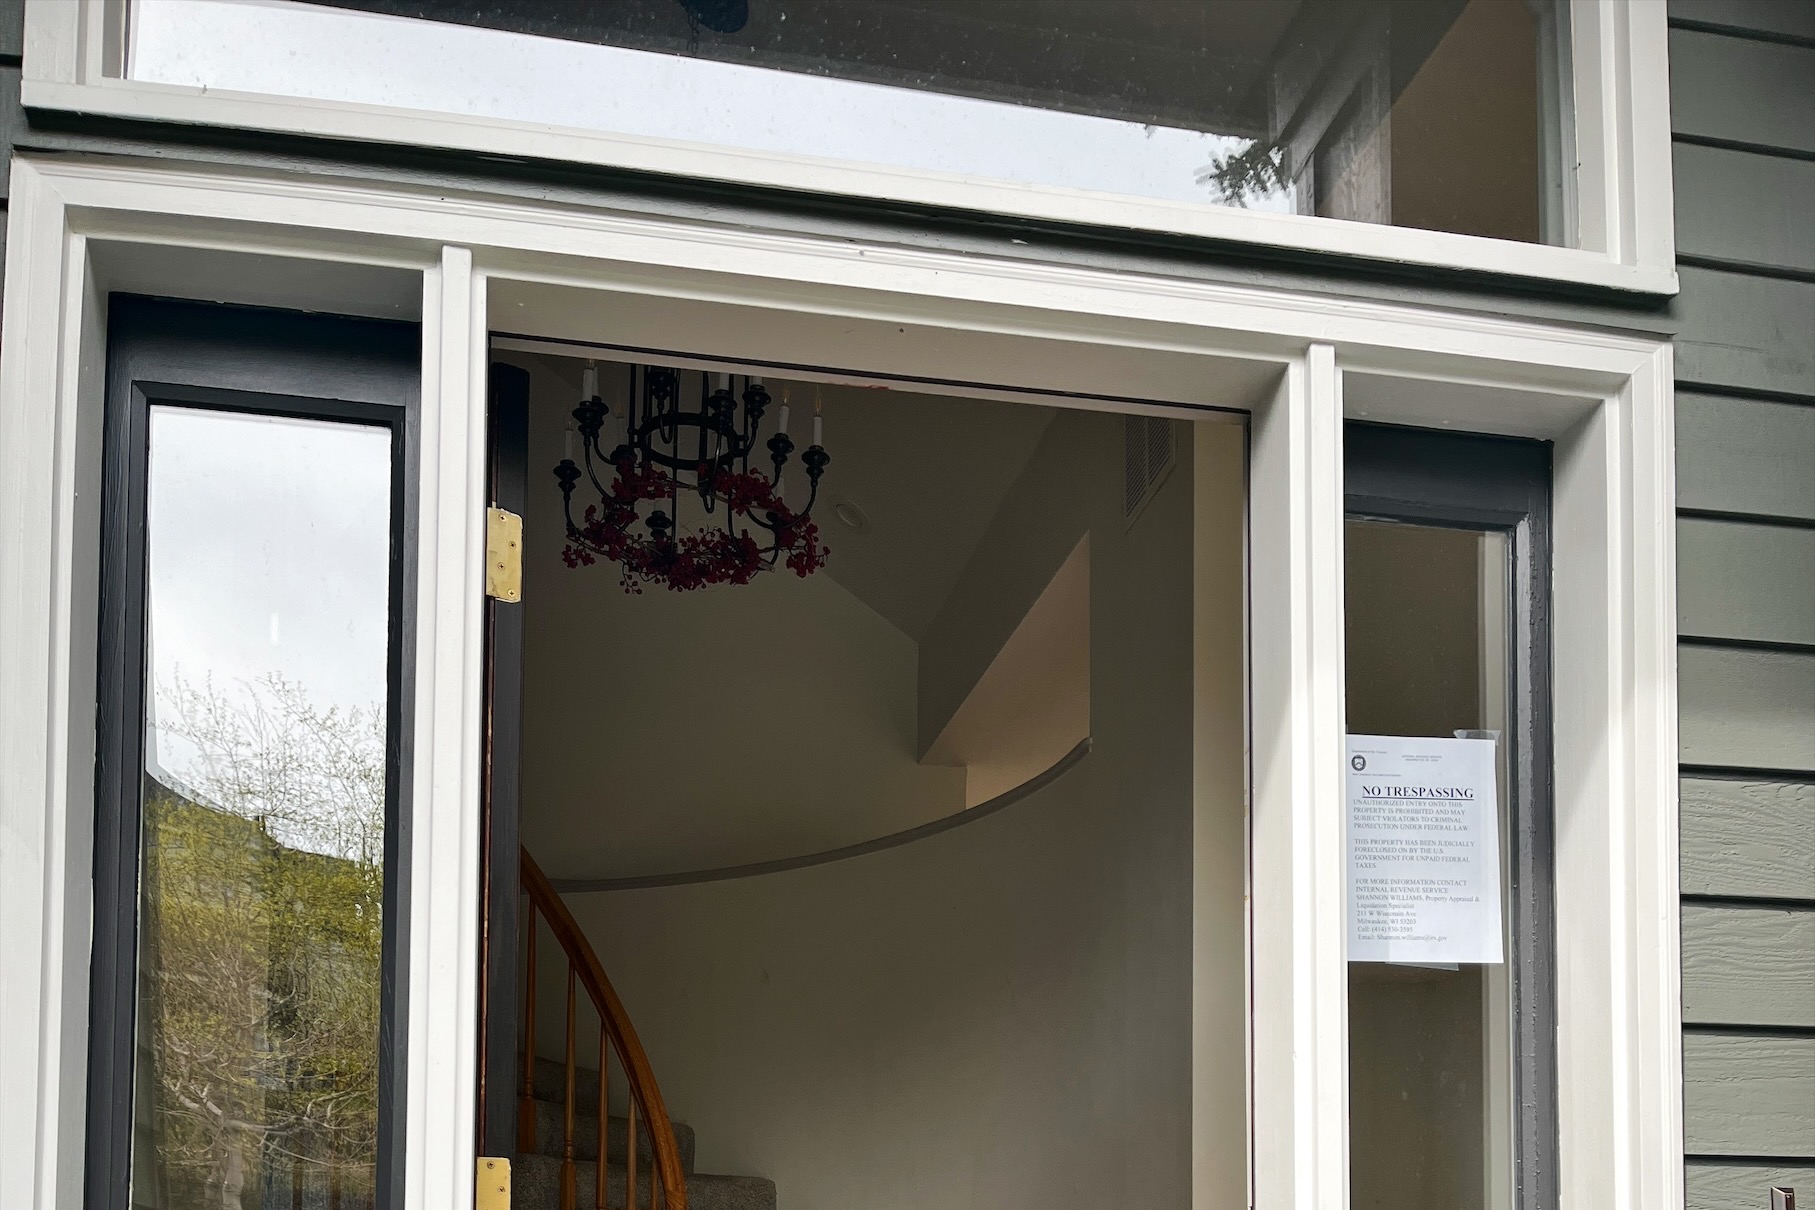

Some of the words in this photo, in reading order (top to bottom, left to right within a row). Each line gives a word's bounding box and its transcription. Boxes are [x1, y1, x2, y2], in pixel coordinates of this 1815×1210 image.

[1362, 786, 1381, 797] NO
[1385, 786, 1473, 799] TRESPASSING
[1354, 822, 1399, 830] PROSECUTION
[1437, 840, 1475, 848] JUDICIALLY
[1437, 879, 1468, 887] CONTACT
[1425, 895, 1448, 903] Property
[1449, 895, 1474, 903] Appraisal
